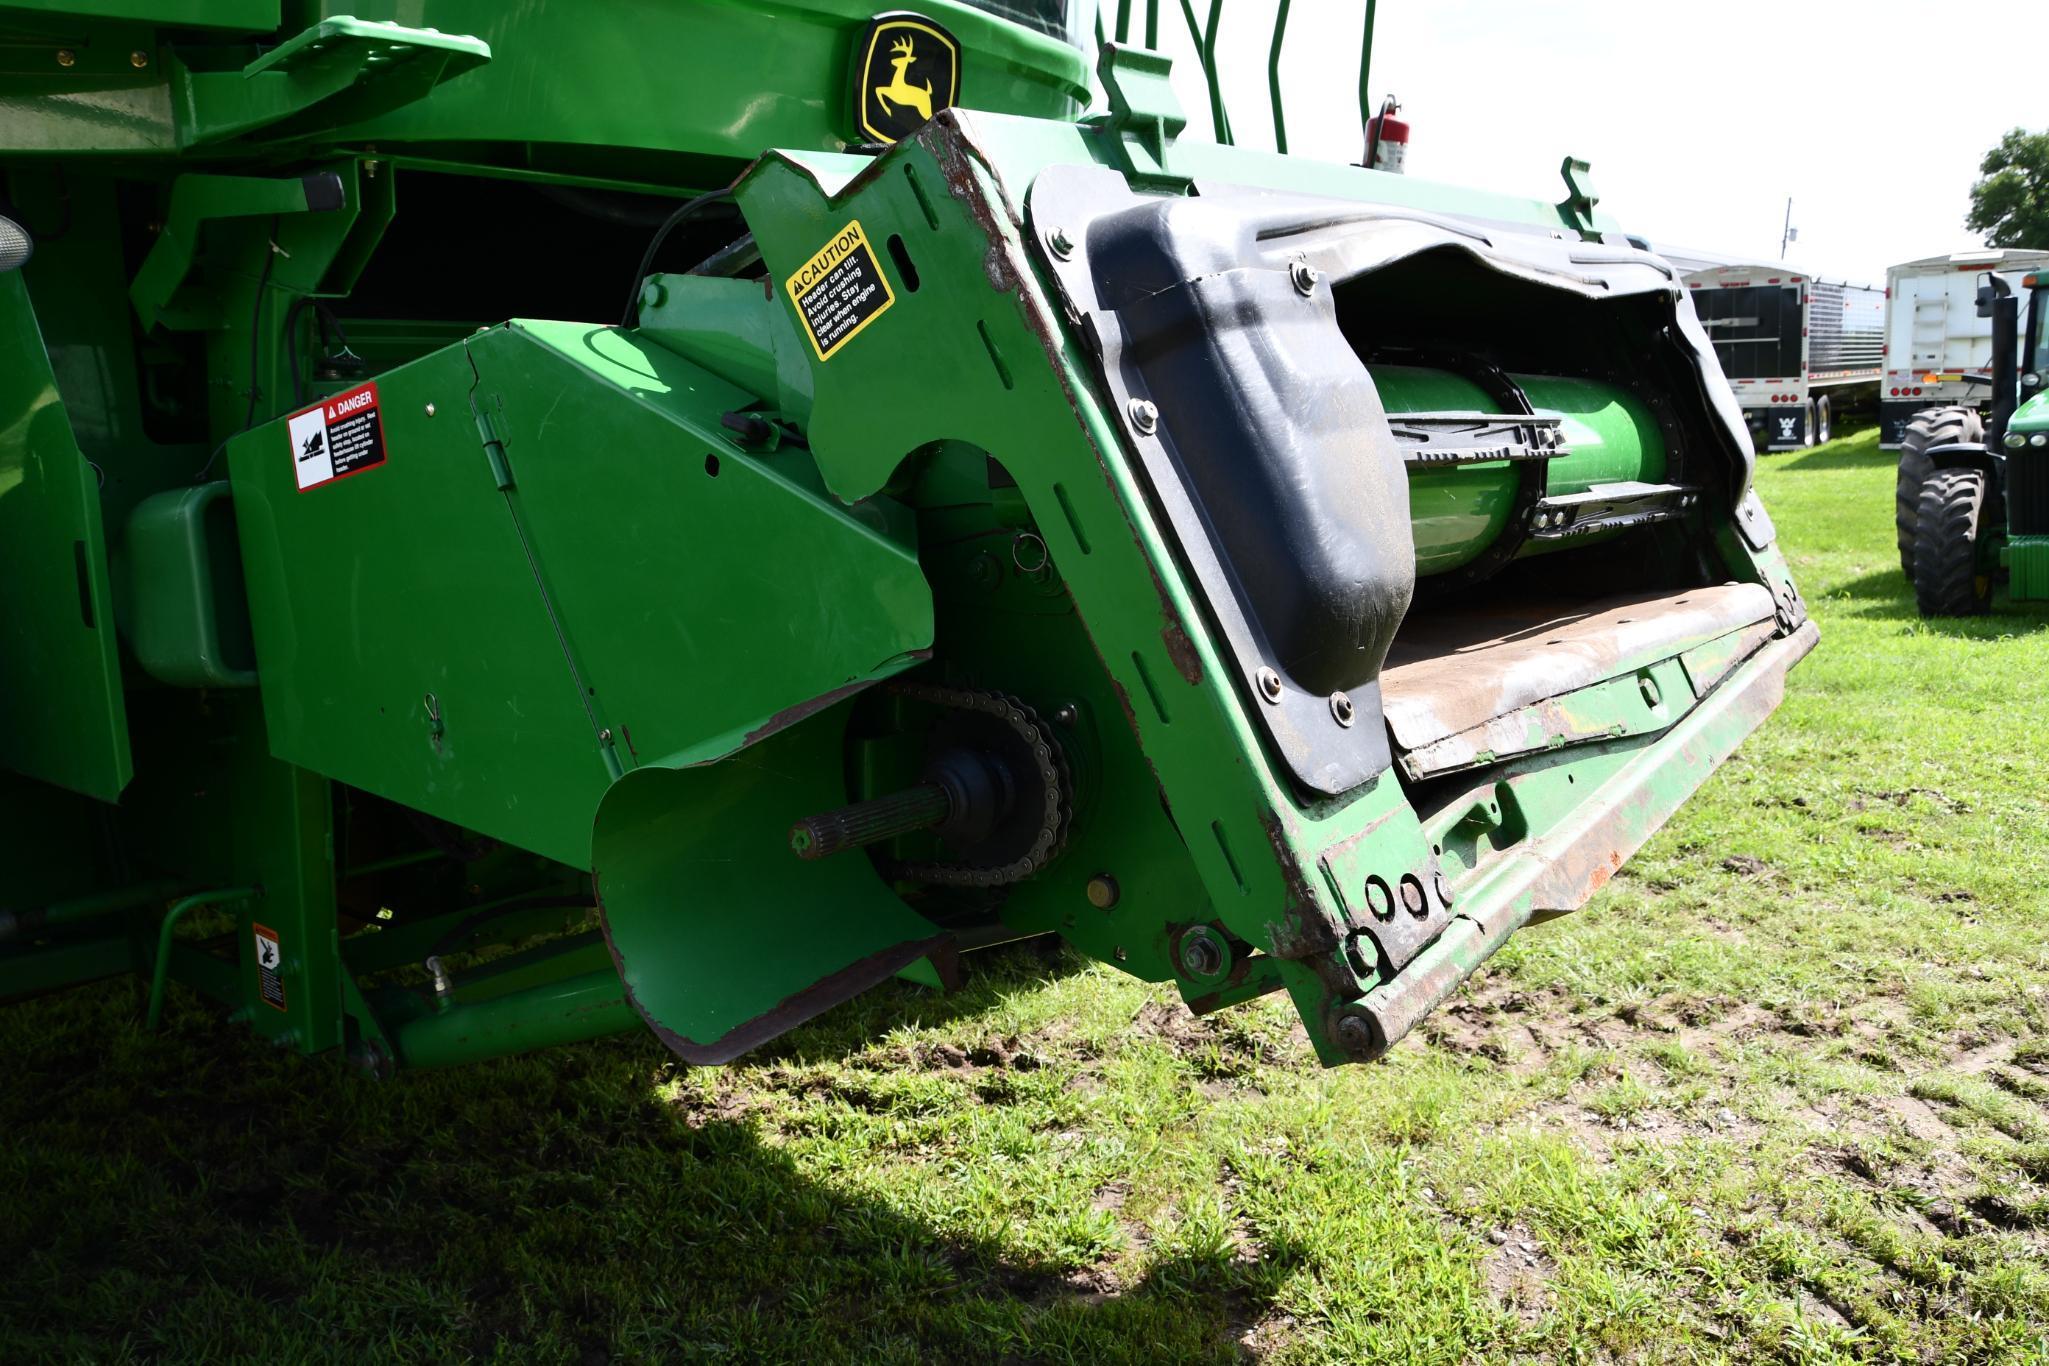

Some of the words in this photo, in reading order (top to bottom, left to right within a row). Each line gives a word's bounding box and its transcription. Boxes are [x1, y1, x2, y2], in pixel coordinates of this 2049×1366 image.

[801, 227, 860, 286] CAUTION
[801, 281, 829, 307] Header
[829, 268, 844, 284] can
[844, 255, 859, 270] tilt.
[807, 295, 828, 317] Avoid
[829, 267, 862, 298] crushing
[811, 302, 841, 328] injuries.
[841, 283, 860, 301] Stay
[816, 320, 833, 337] clear
[833, 305, 853, 323] when
[852, 283, 876, 306] engine
[820, 338, 829, 347] is
[829, 314, 859, 341] running.
[338, 391, 372, 415] DANGER
